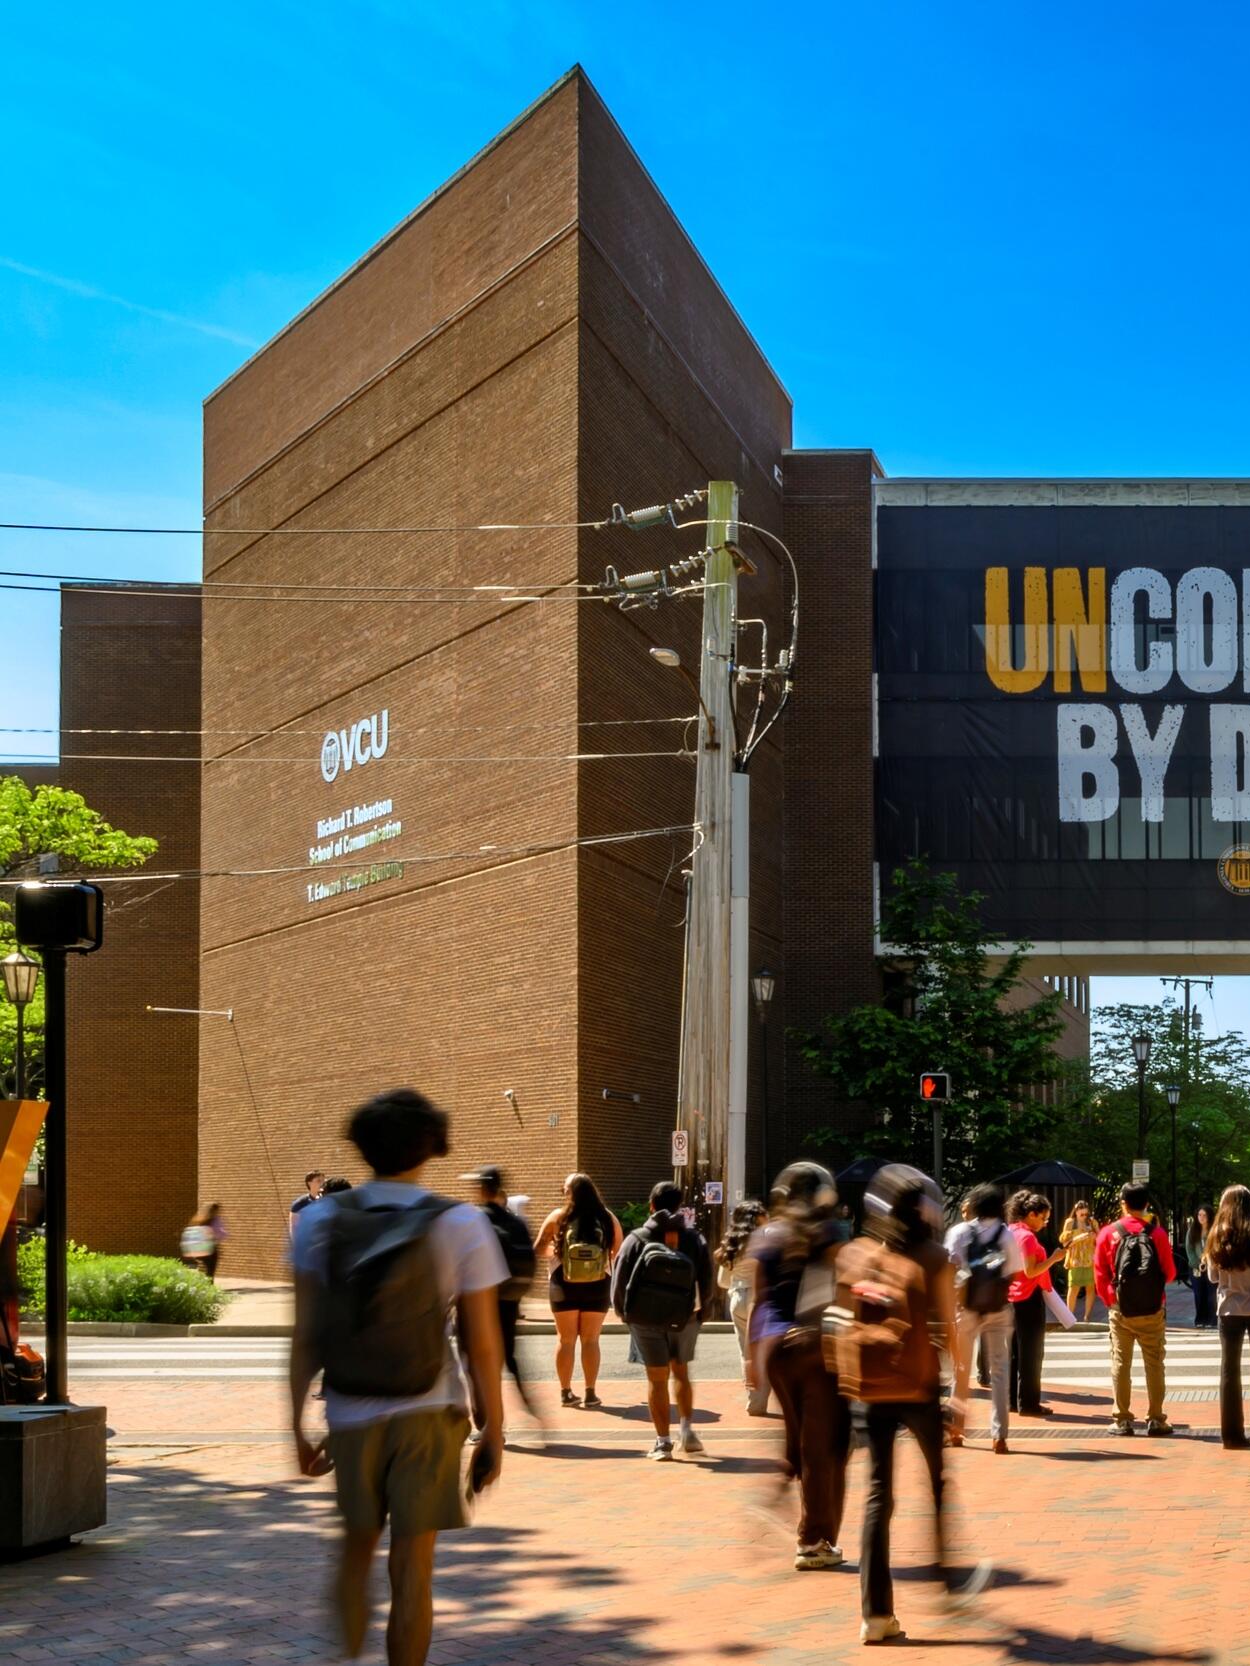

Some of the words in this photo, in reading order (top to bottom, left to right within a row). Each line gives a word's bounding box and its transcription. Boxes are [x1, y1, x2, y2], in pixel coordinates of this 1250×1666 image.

[339, 708, 389, 772] VCU
[1057, 703, 1187, 822] BY
[309, 840, 334, 866] School
[334, 837, 343, 857] of
[343, 820, 402, 853] Communication
[317, 811, 345, 839] Richard
[345, 809, 353, 828] T.
[353, 799, 392, 825] Robertson
